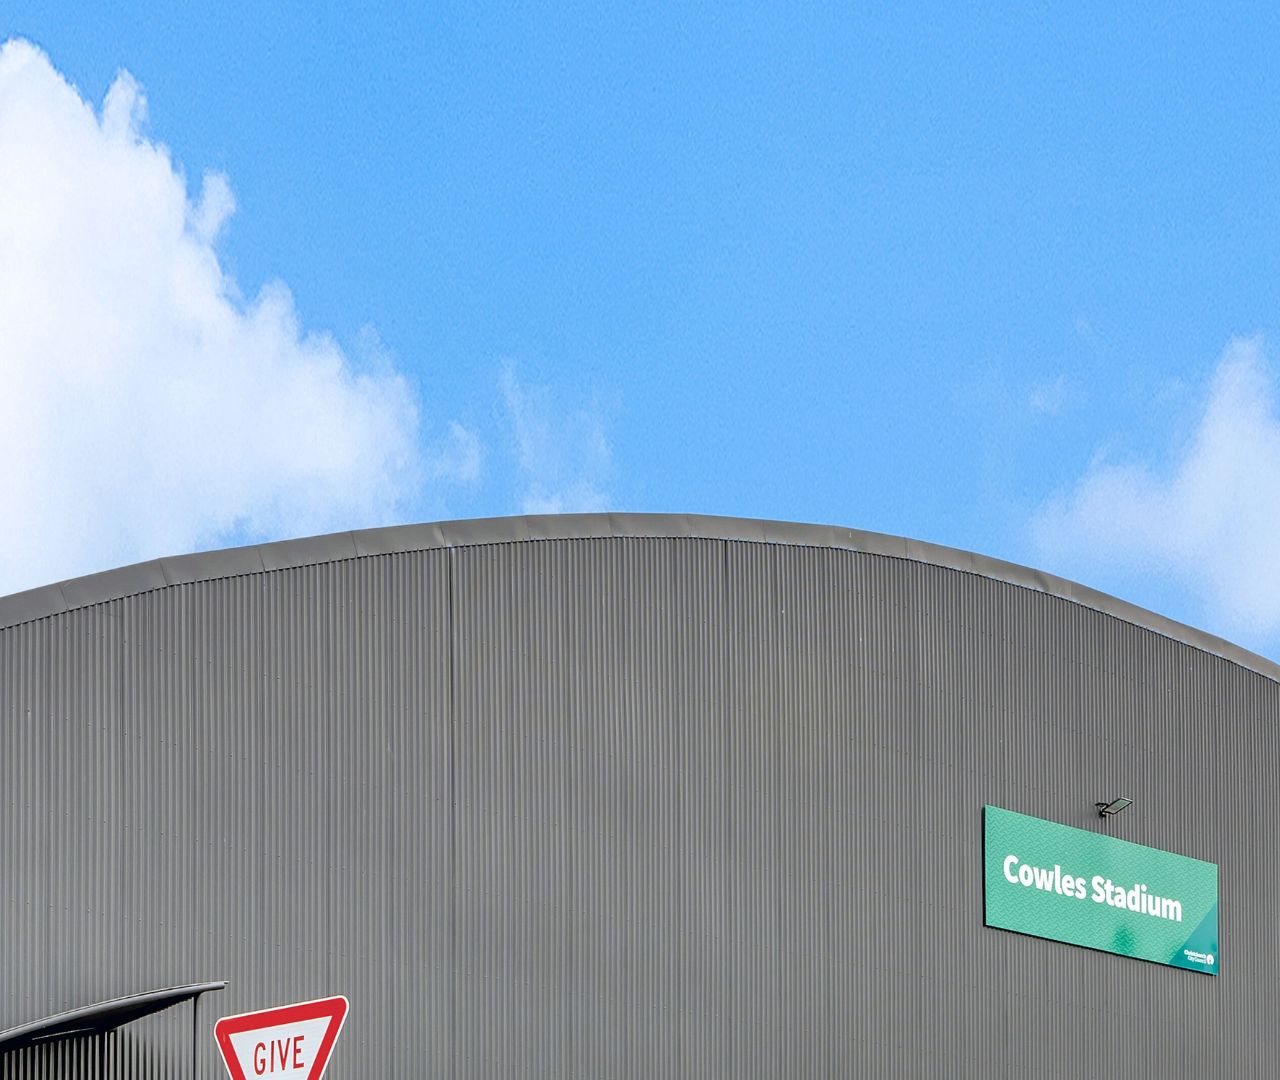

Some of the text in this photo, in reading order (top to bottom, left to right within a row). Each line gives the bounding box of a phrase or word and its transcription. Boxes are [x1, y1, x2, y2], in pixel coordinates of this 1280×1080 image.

[1003, 855, 1182, 922] Cowles Stadium
[254, 1035, 305, 1076] GIVE
